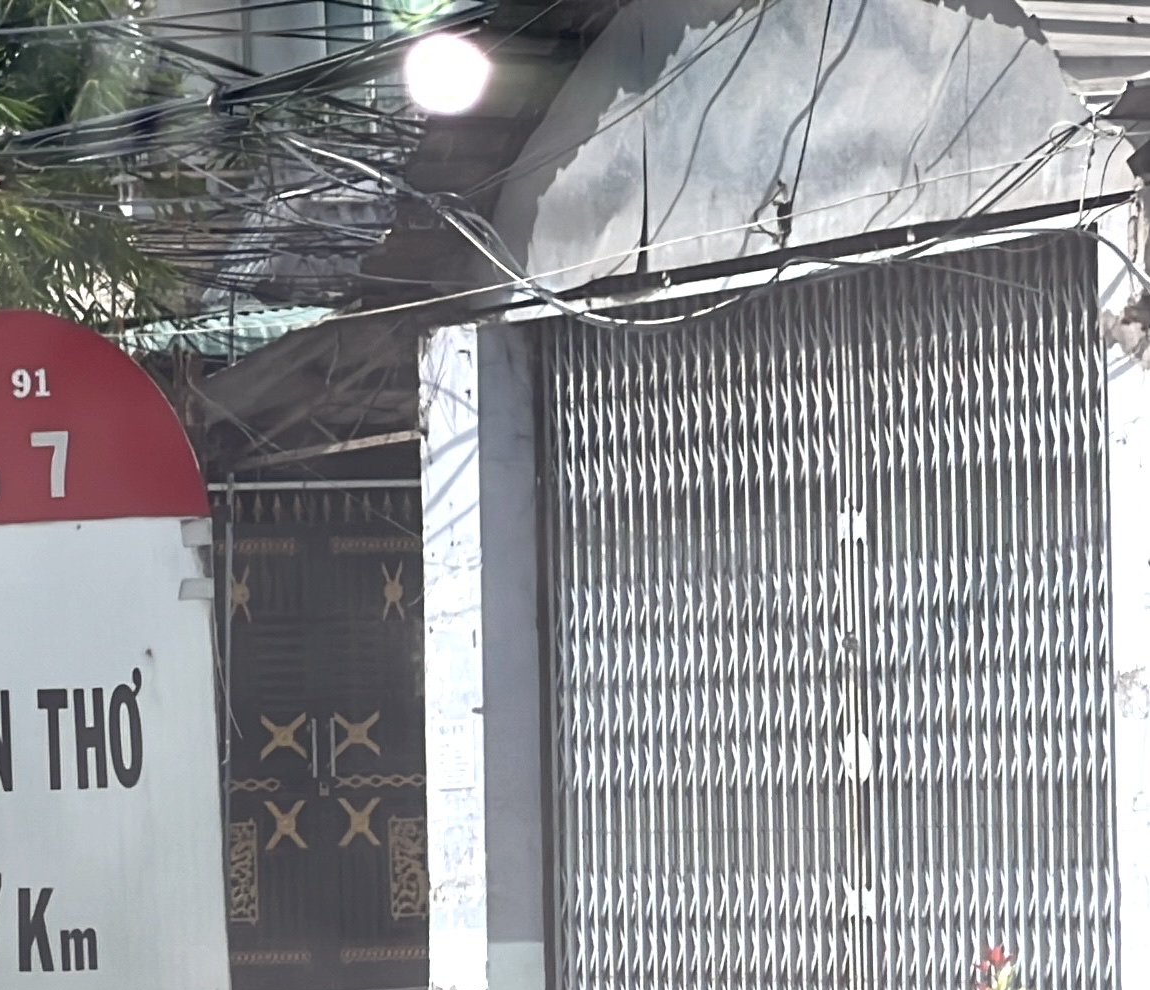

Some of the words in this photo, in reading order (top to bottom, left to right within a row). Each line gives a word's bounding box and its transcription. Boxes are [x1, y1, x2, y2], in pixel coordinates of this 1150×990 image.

[11, 368, 51, 399] 91
[30, 430, 69, 498] 7
[36, 667, 143, 791] THƠ
